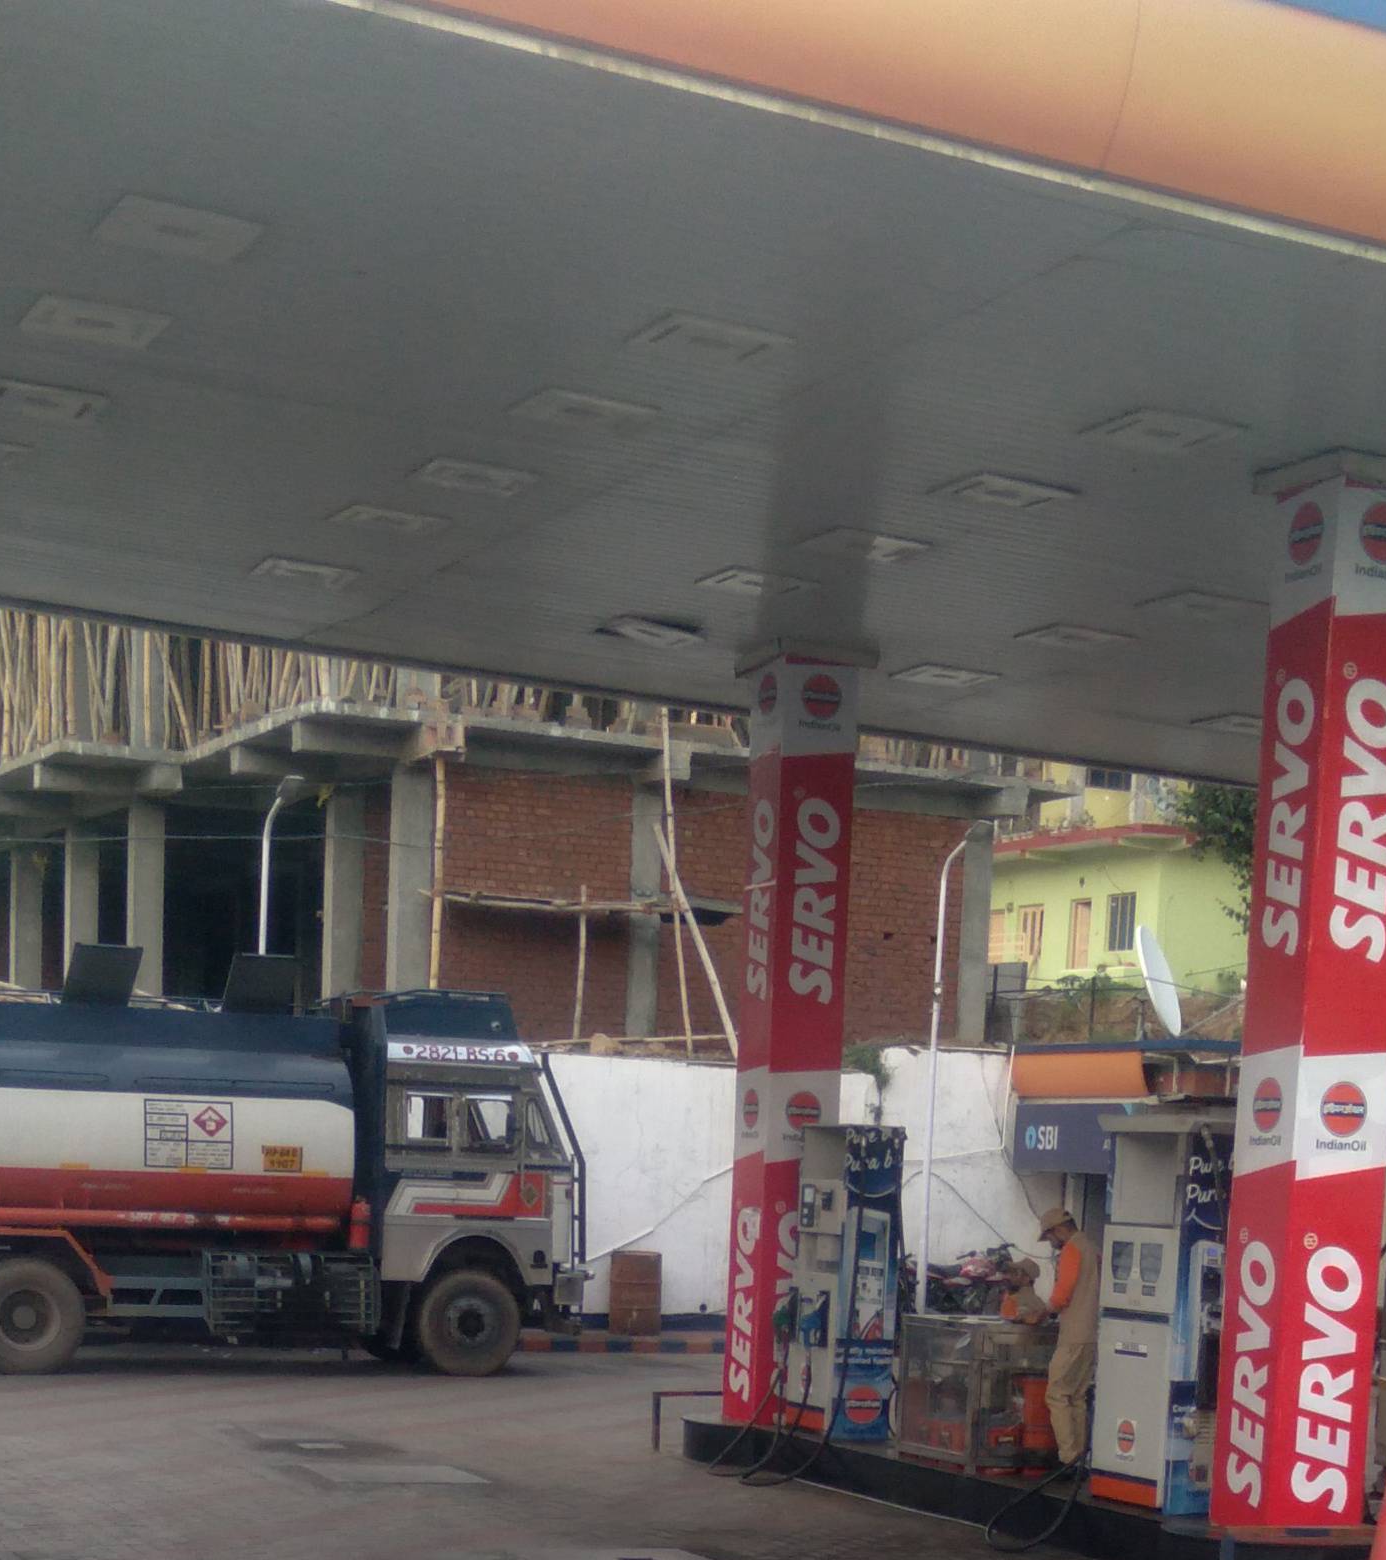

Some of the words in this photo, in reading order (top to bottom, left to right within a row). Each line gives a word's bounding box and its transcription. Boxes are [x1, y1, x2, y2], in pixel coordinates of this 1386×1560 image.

[746, 799, 774, 1001] SERVO
[788, 798, 841, 1005] SERVO
[1262, 678, 1314, 955] SERVO
[1037, 1125, 1059, 1150] SBI
[1315, 1139, 1366, 1152] IndianOil
[728, 1207, 762, 1402] SERVO
[1226, 1241, 1276, 1509] SERVO
[1291, 1246, 1362, 1514] SERVO
